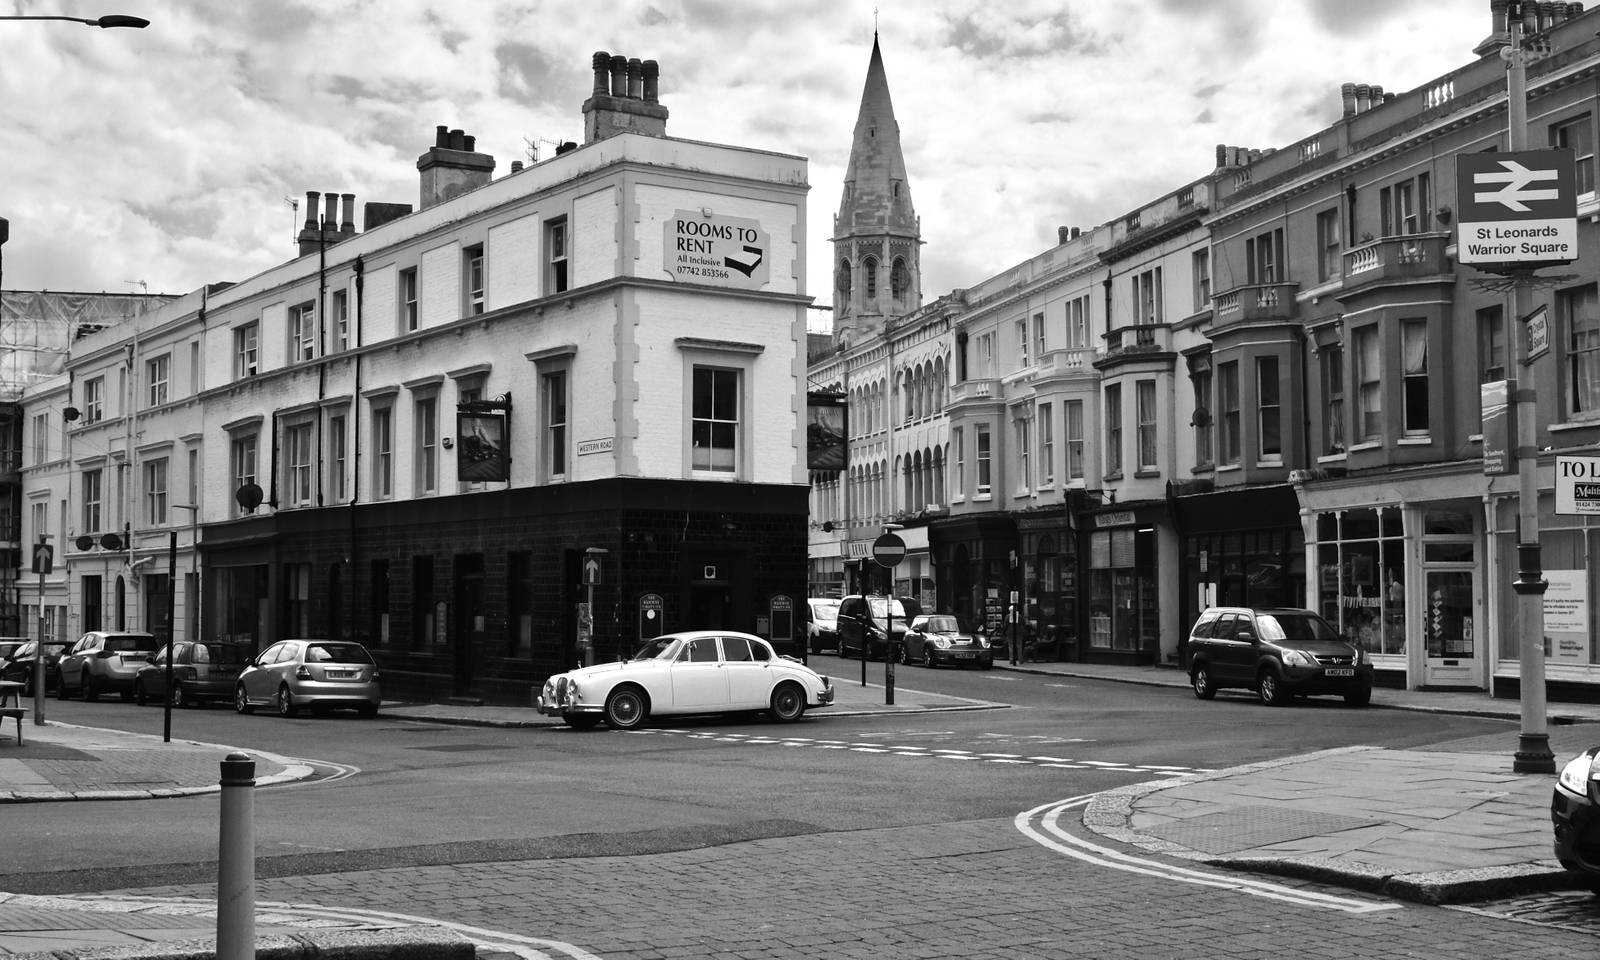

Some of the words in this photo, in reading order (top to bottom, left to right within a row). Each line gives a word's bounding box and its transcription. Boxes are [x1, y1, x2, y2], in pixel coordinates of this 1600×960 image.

[677, 220, 733, 240] ROOMS
[737, 227, 758, 243] TO
[1477, 228, 1491, 239] St
[1495, 226, 1559, 239] Leonards
[677, 237, 715, 254] RENT
[1468, 243, 1517, 255] Warrior
[1521, 242, 1569, 256] Square
[677, 254, 688, 263] All
[690, 256, 721, 267] Inclusive
[677, 266, 700, 276] 07742
[702, 268, 729, 279] 853566
[579, 442, 600, 454] WESTERN
[600, 440, 612, 450] ROAD
[1560, 462, 1586, 478] TO
